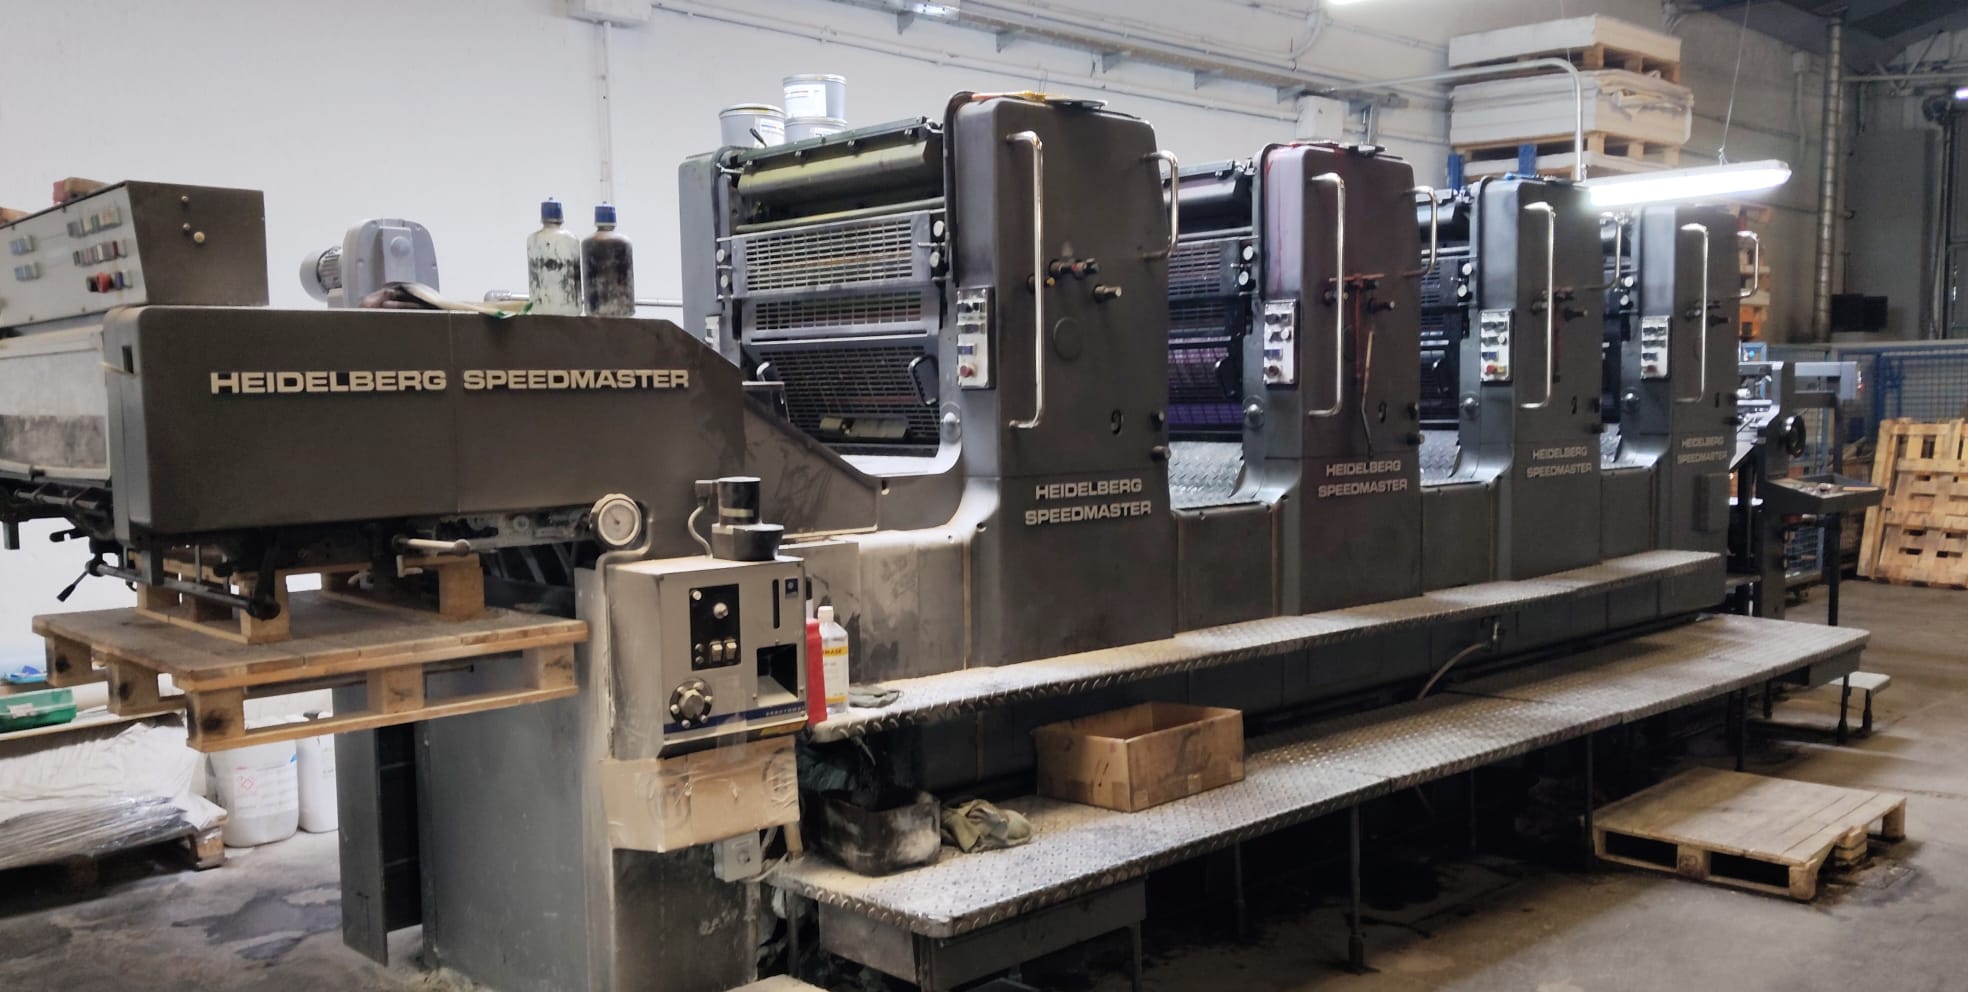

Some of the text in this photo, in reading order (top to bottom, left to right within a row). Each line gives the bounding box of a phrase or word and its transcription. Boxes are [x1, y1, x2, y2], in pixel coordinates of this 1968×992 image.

[210, 369, 689, 394] HEIDELBERG SPEEDMASTER
[1326, 460, 1401, 477] HEIDELBERG
[1035, 478, 1142, 500] HEIDELBERG
[1318, 479, 1408, 497] SPEEDMASTER
[1025, 501, 1152, 525] SPEEDMASTER
